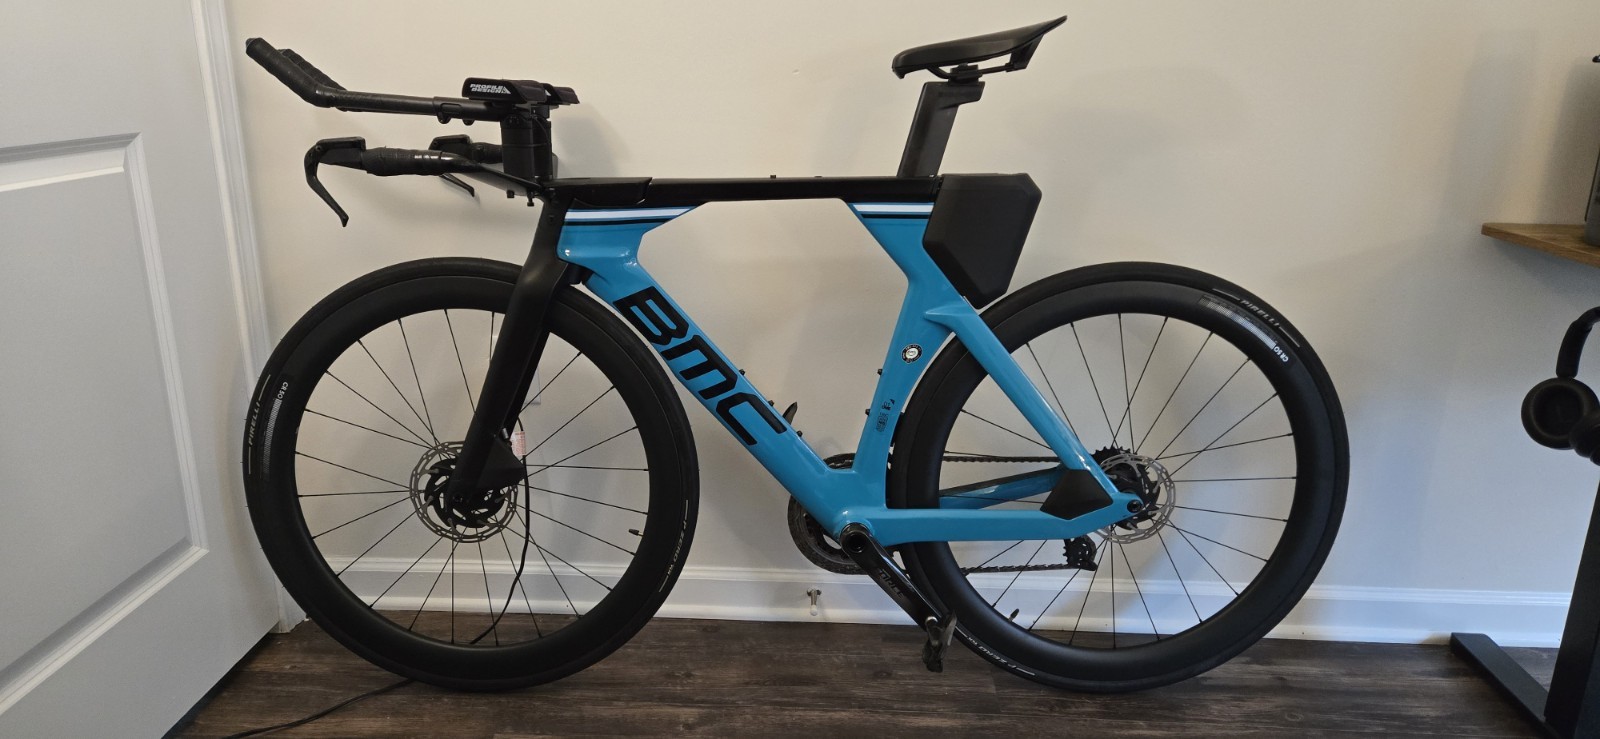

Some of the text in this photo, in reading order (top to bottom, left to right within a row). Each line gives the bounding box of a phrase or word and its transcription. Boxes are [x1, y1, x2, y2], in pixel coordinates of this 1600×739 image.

[1240, 299, 1280, 327] PIRELLI
[613, 286, 787, 446] BMC
[248, 402, 261, 445] PIRELLI
